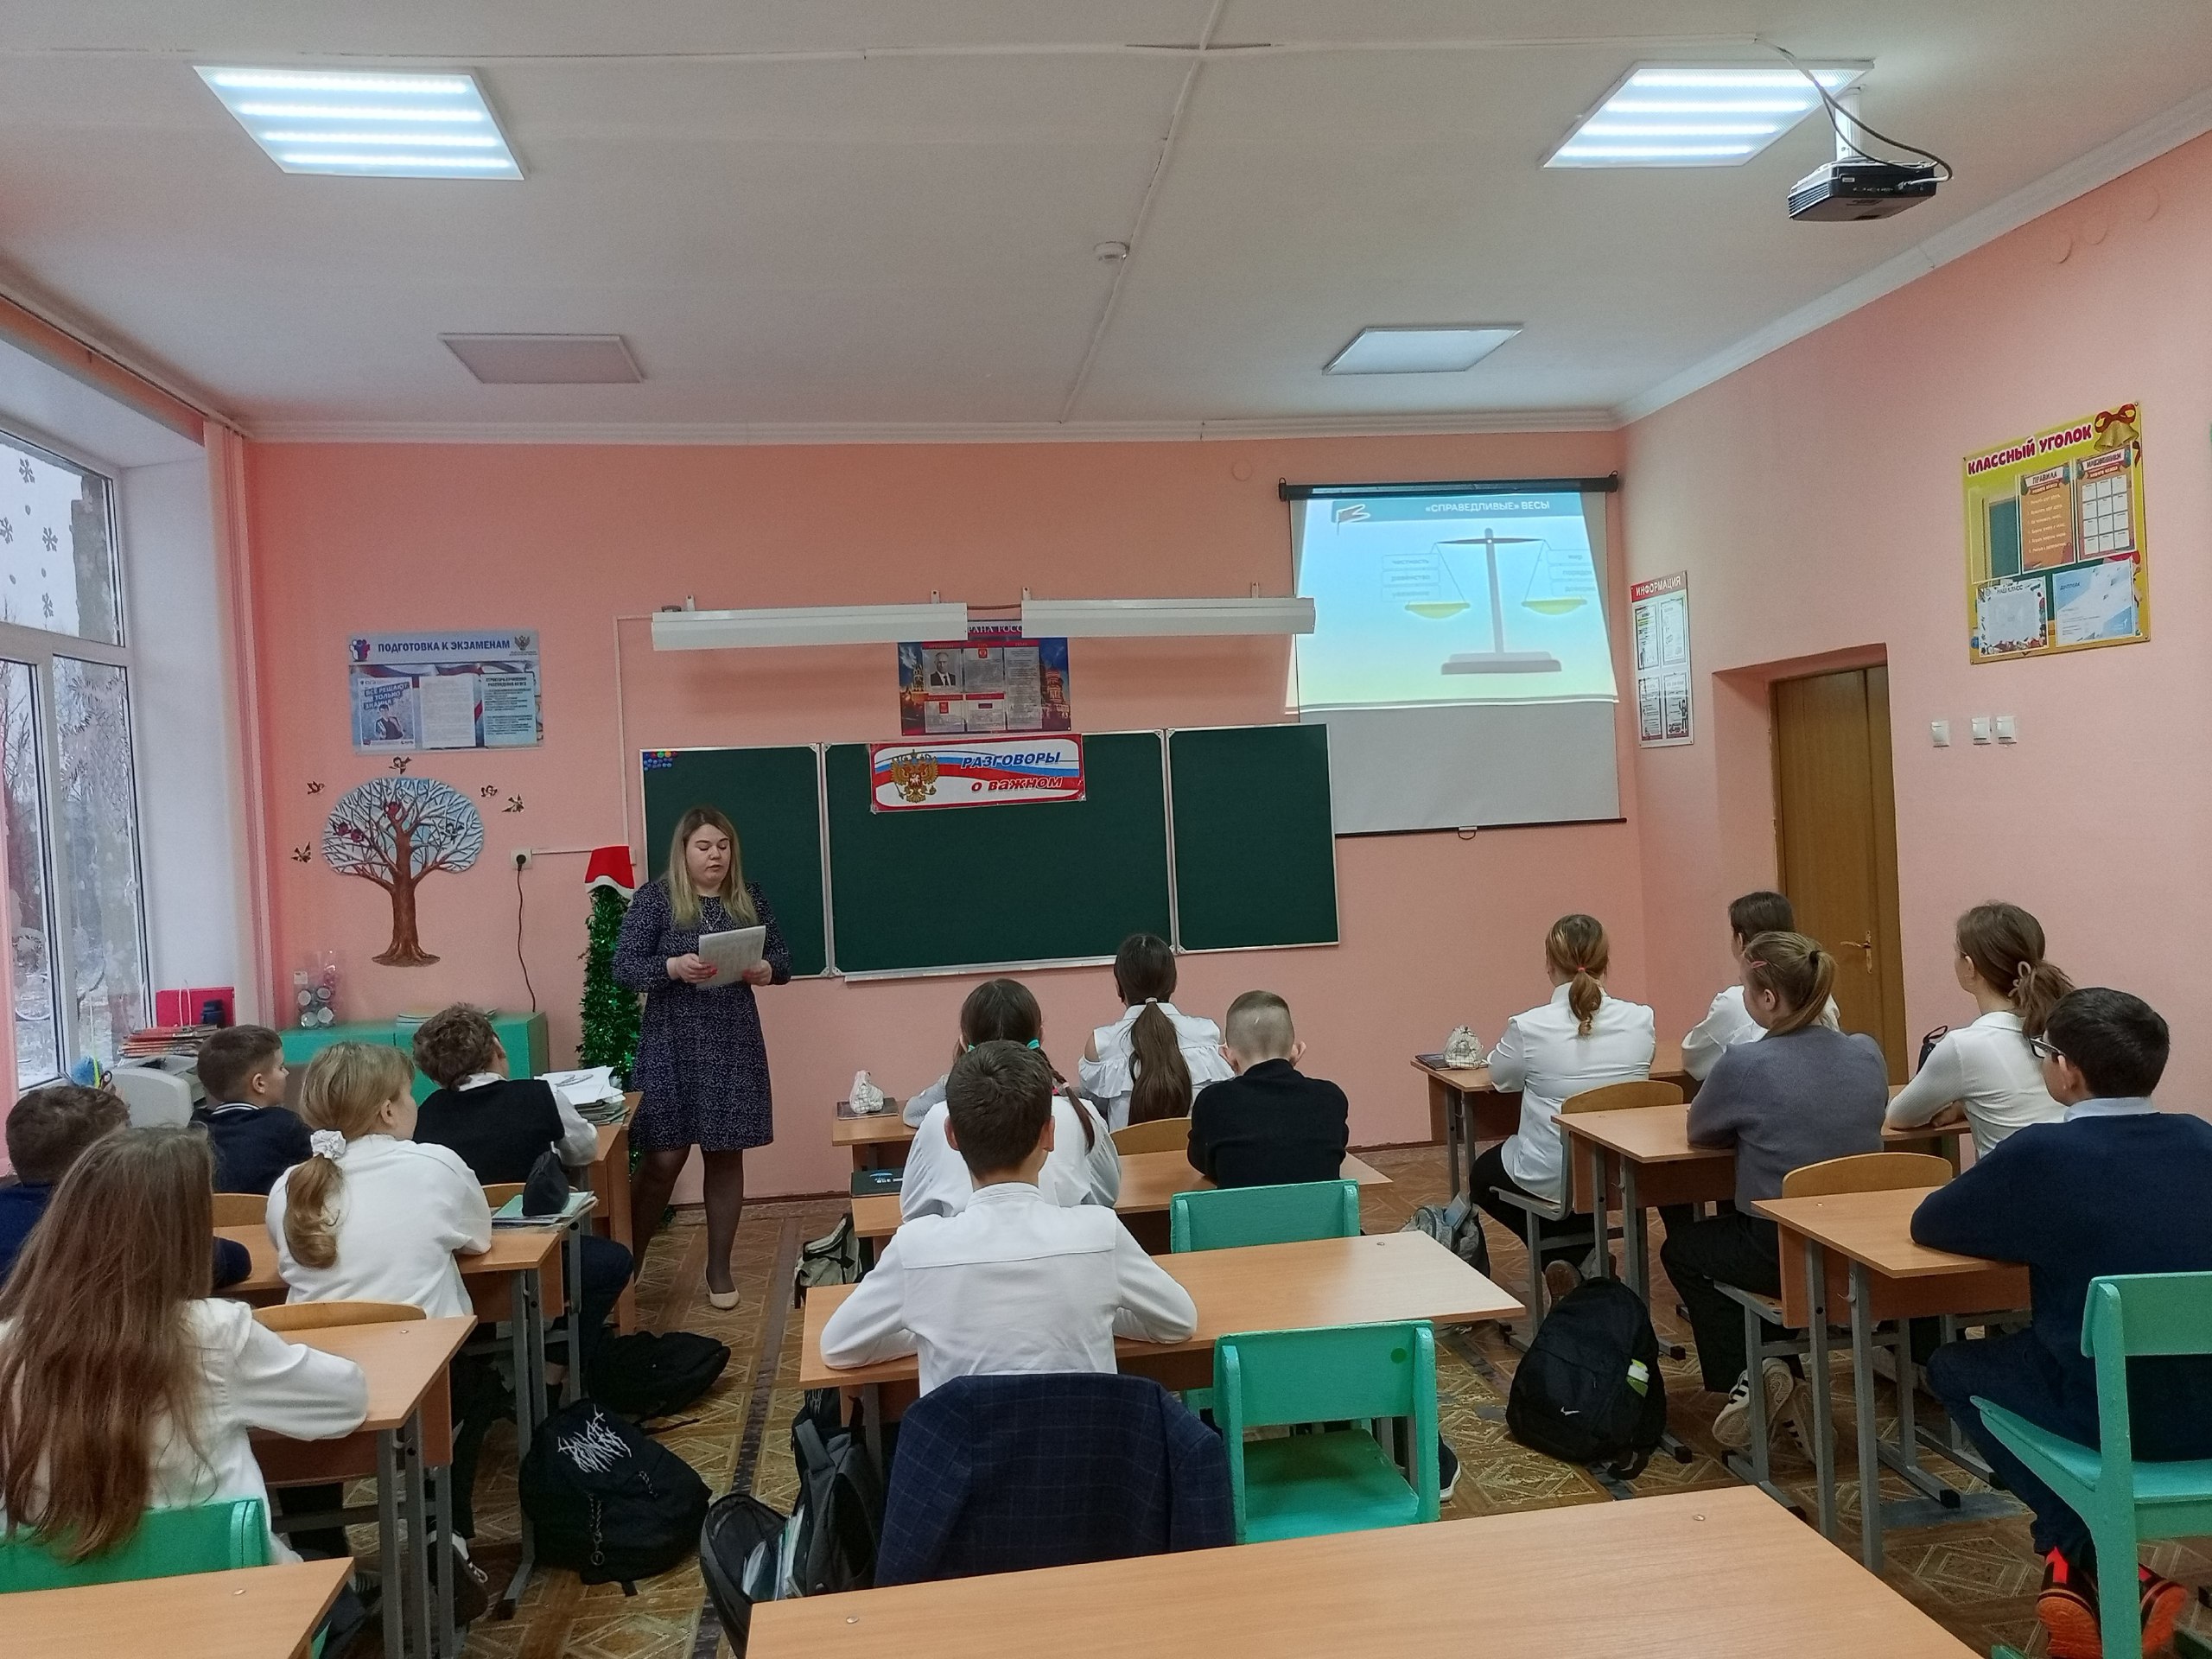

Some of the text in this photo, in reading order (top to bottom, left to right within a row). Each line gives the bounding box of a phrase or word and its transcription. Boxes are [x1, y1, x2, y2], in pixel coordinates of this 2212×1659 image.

[1967, 424, 2093, 475] КЛАССНЫЙ УГОЛОК
[2032, 471, 2057, 485] ПРАВИЛА
[1426, 500, 1550, 512] «СПРАВЕДЛИВЫЕ» ВЕСЫ
[1636, 575, 1681, 597] ИНФОРМАЦИЯ
[968, 624, 1022, 633] РАНА РОСС
[378, 639, 511, 654] ПОДГОТОВКА К ЭКЗАМЕНАМ
[962, 752, 1061, 768] РАЗГОВОРЫ
[970, 776, 1063, 792] о важном
